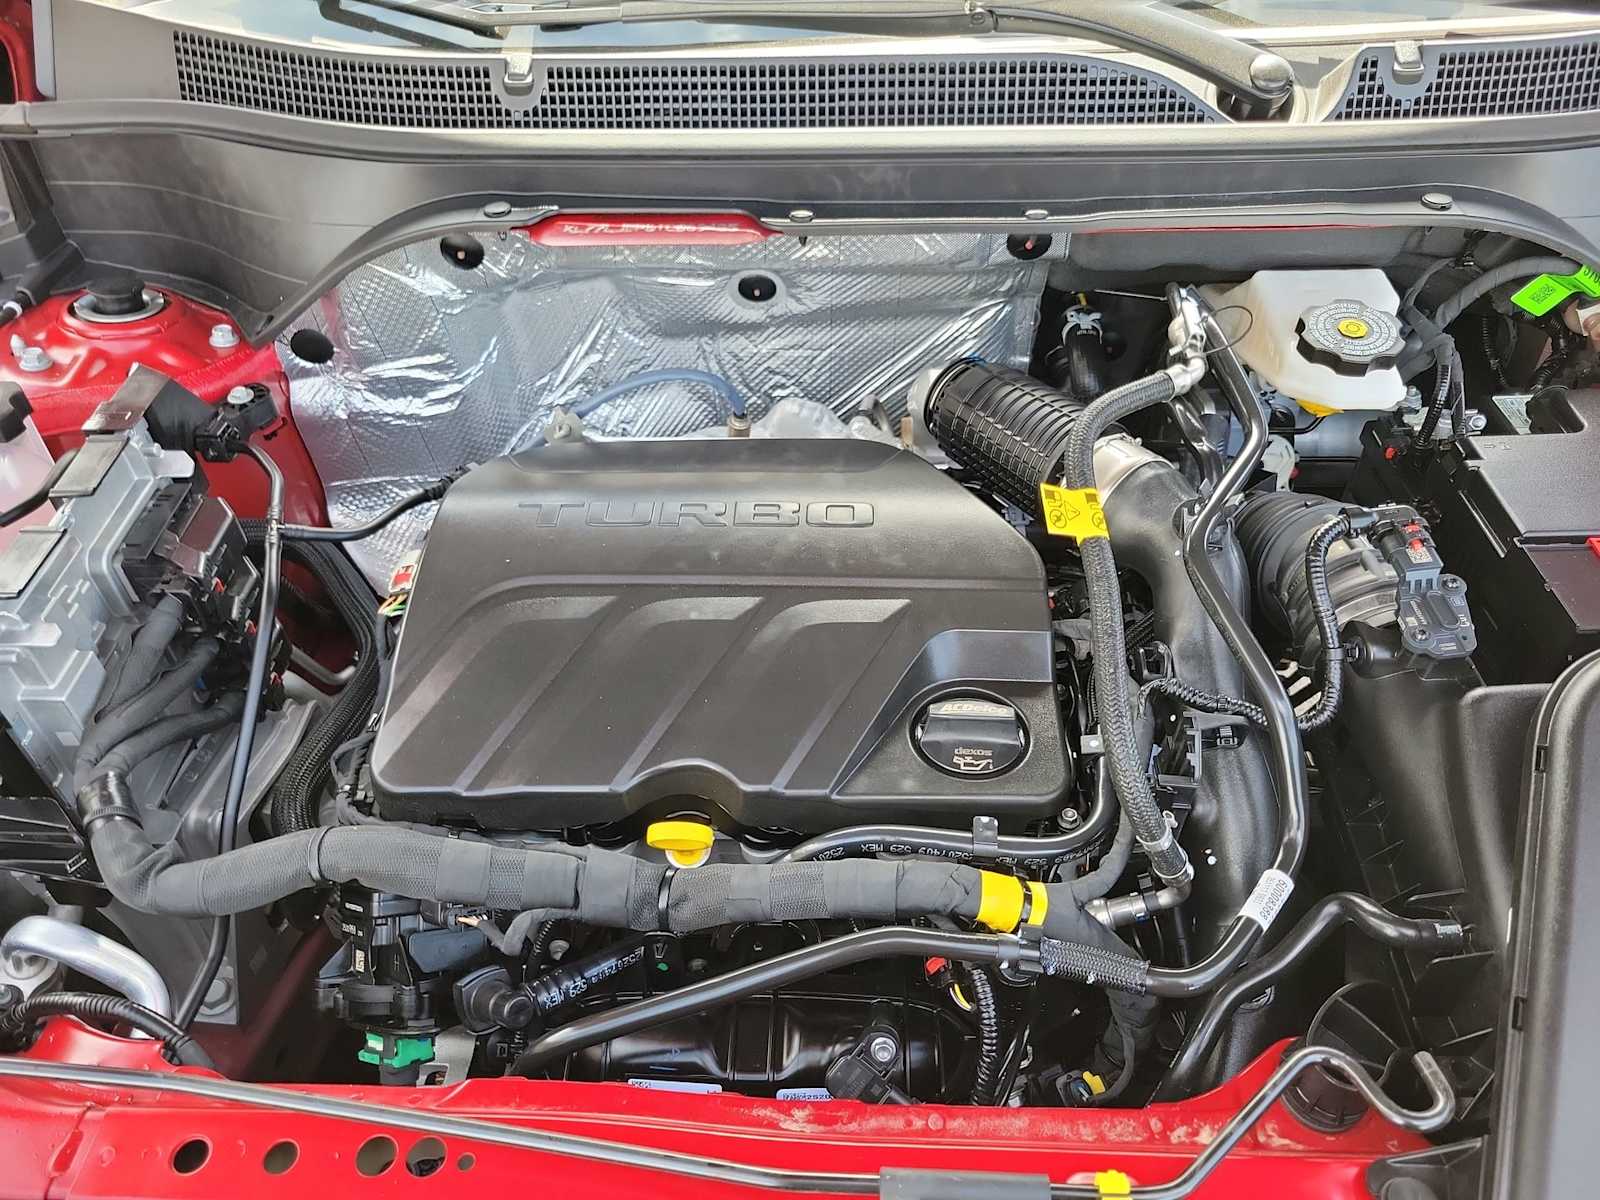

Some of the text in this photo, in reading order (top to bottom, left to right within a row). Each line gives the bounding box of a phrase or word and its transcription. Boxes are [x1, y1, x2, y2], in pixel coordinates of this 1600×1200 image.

[518, 500, 875, 528] TURBO
[943, 703, 1007, 713] ACDelco
[954, 747, 993, 756] dexos
[860, 843, 884, 853] MEX
[890, 844, 912, 854] 529
[569, 979, 588, 998] 529
[543, 987, 565, 1009] MEX
